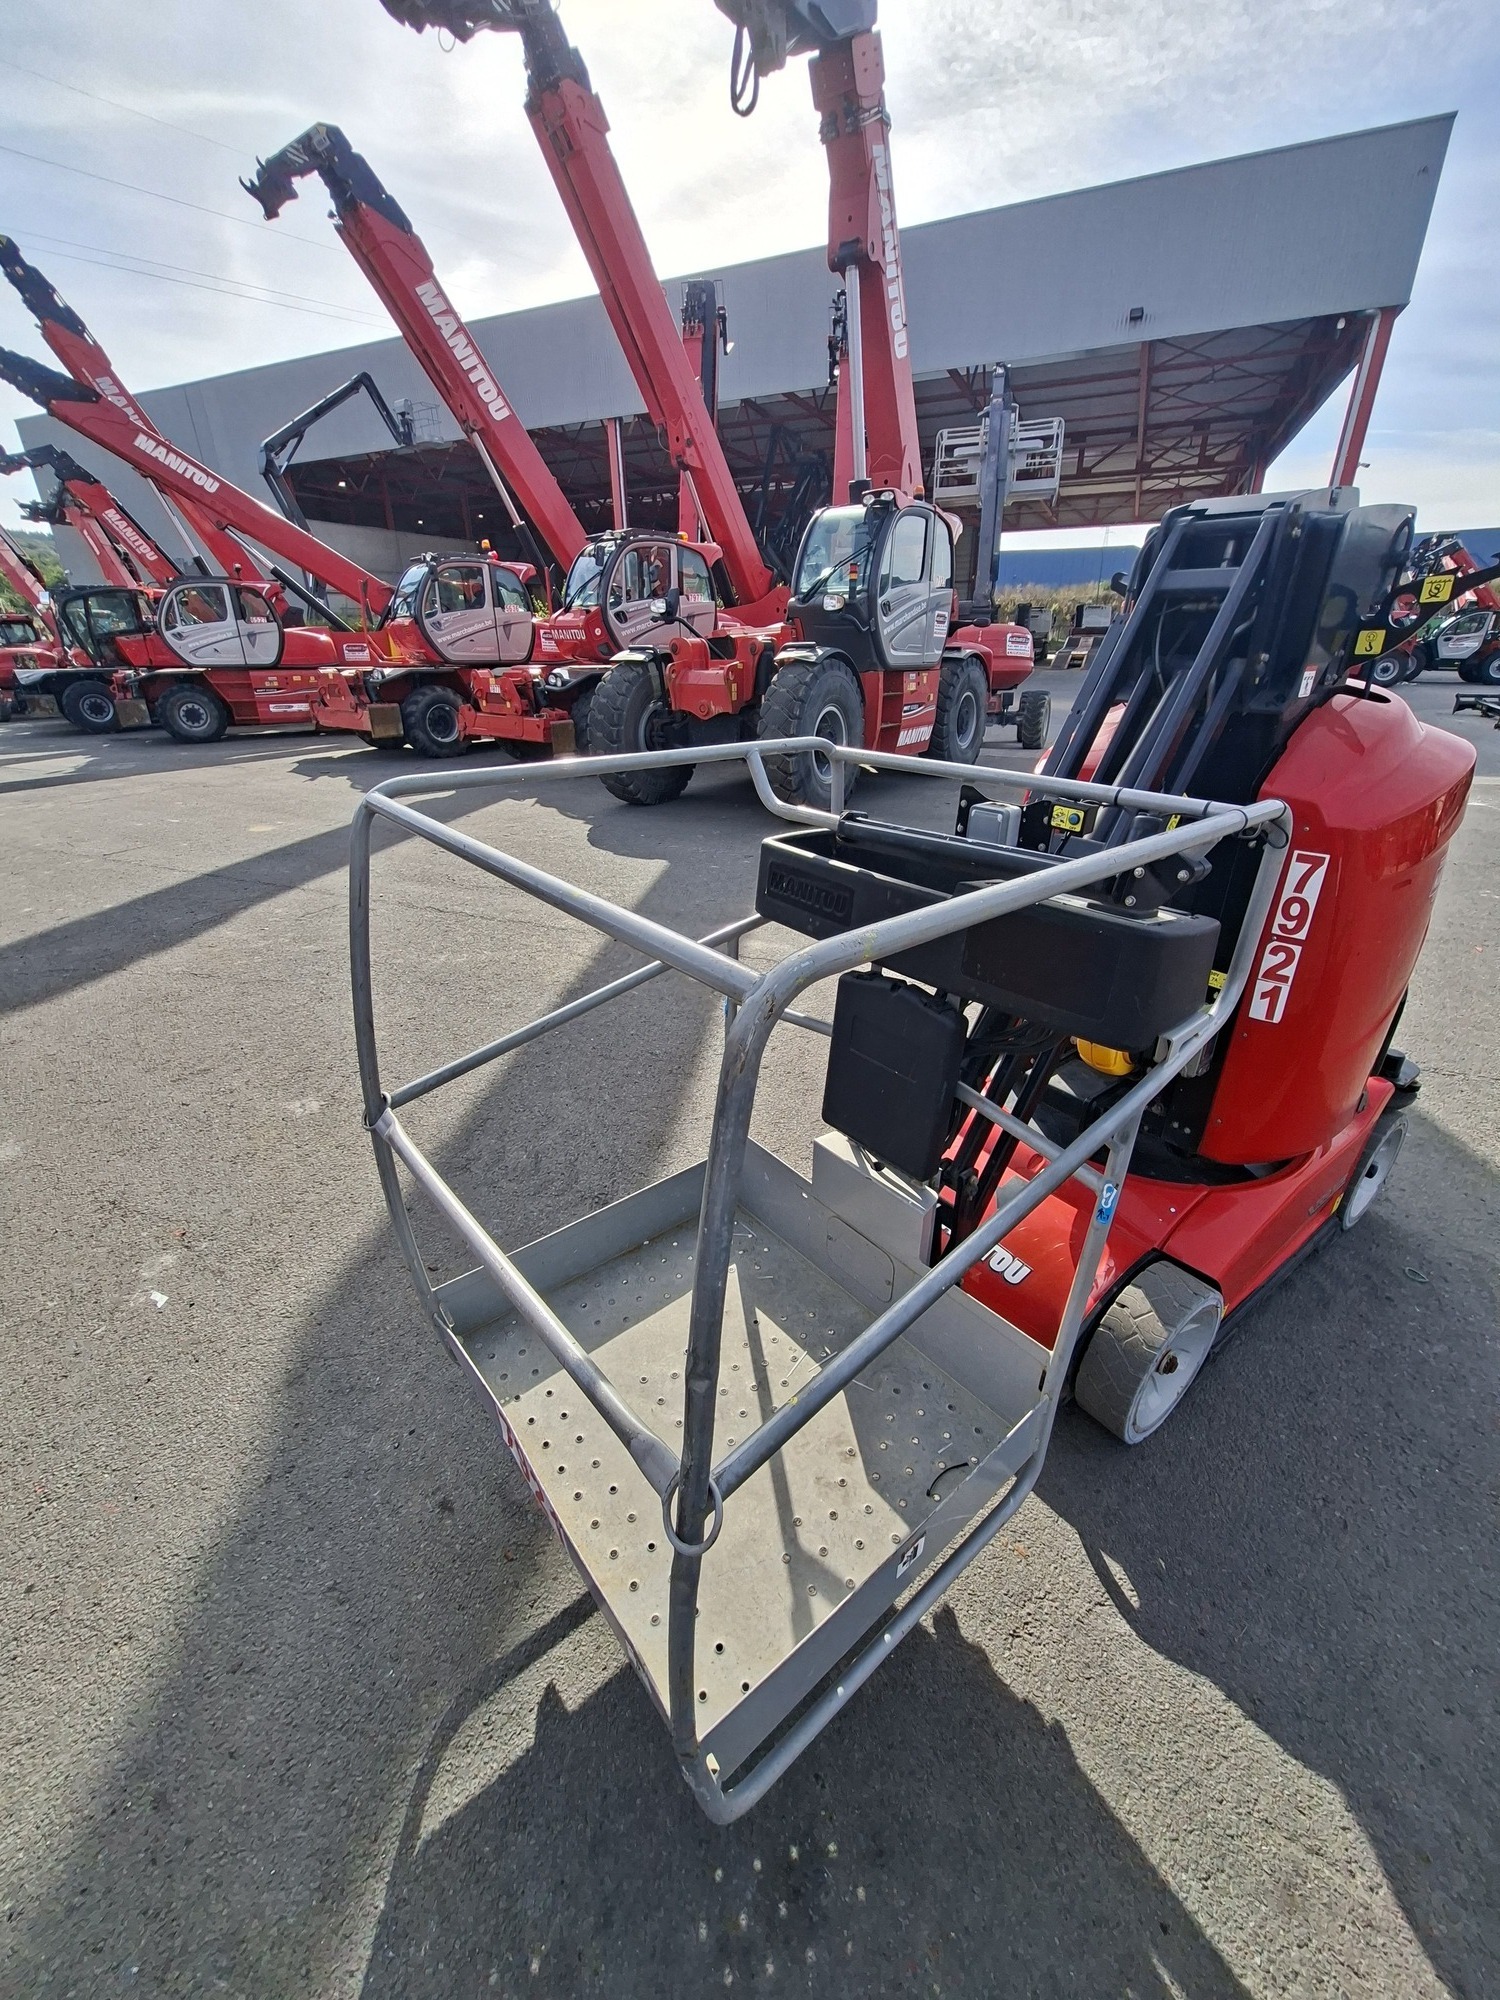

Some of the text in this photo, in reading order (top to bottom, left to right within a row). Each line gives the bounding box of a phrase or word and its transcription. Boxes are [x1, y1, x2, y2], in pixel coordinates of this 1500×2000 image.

[872, 145, 908, 359] MANITOU
[415, 280, 512, 421] MANITOU
[133, 432, 220, 493] MANITOU
[102, 508, 158, 561] MANITOU
[437, 620, 493, 643] www.marchandise.be
[551, 629, 587, 640] MANITOU
[897, 724, 934, 747] MANITOU
[769, 870, 848, 917] MANITOU
[1259, 852, 1326, 1021] 7921
